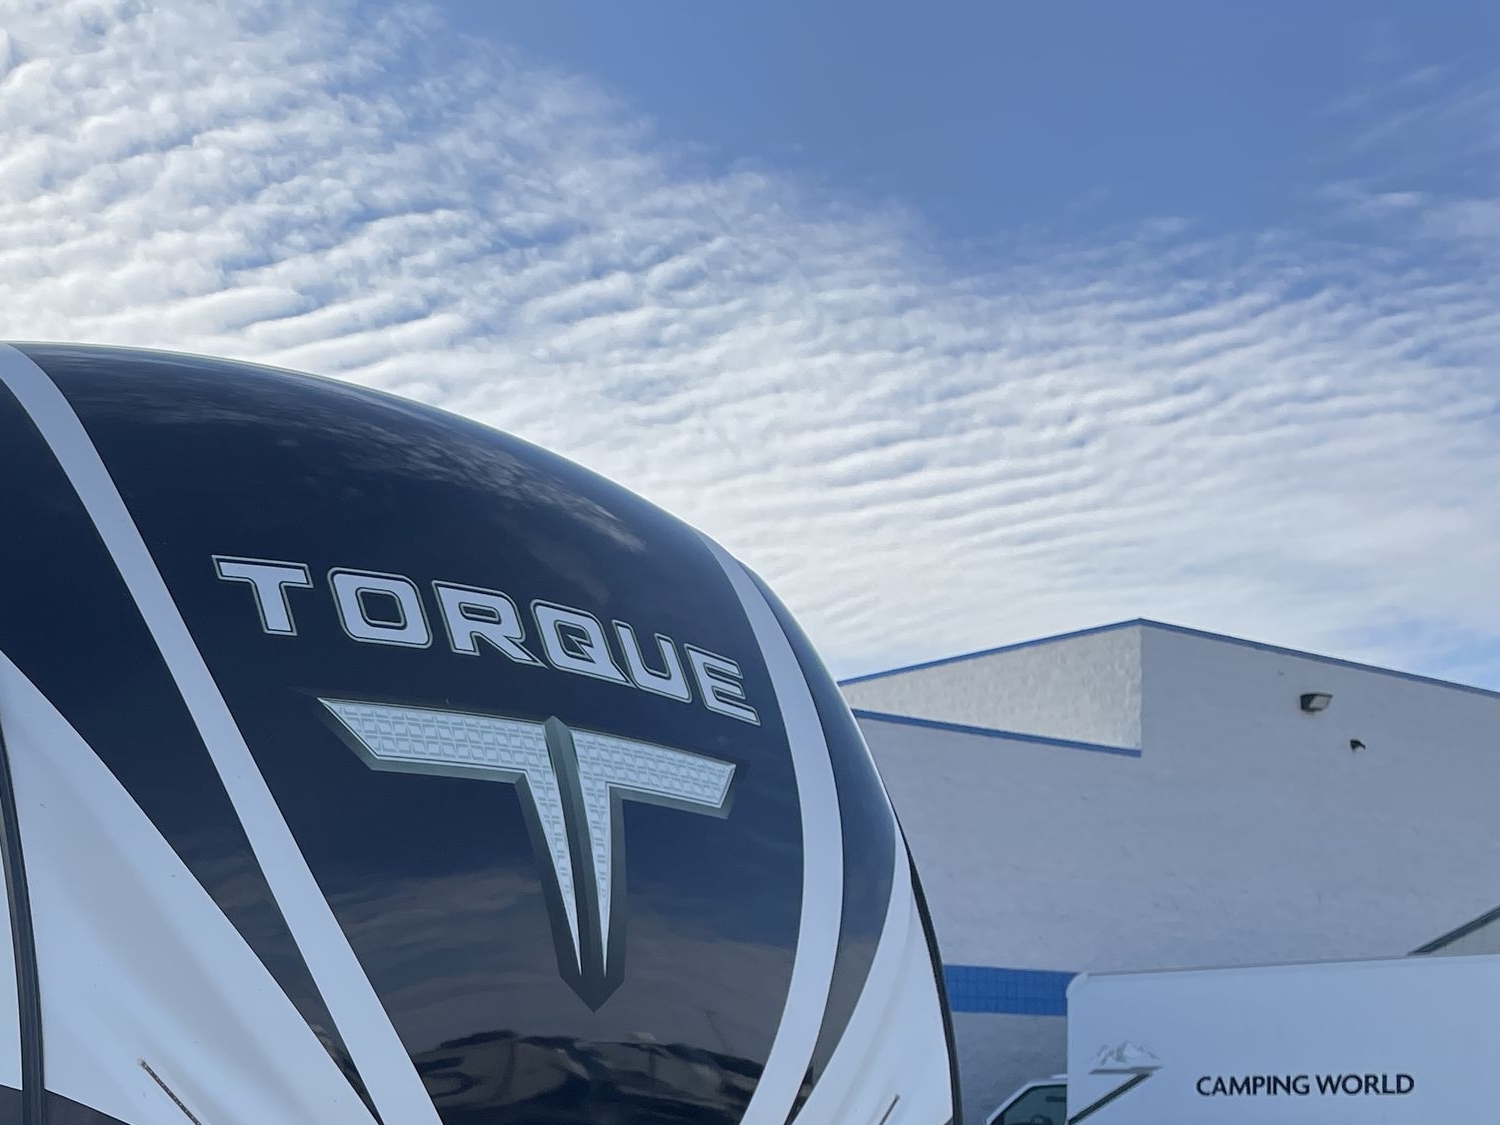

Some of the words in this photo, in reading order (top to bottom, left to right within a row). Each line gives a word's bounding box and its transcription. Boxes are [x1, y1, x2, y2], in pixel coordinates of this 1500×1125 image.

[211, 555, 760, 726] TORQUE
[1195, 1075, 1310, 1097] CAMPING
[1315, 1073, 1415, 1096] WORLD
